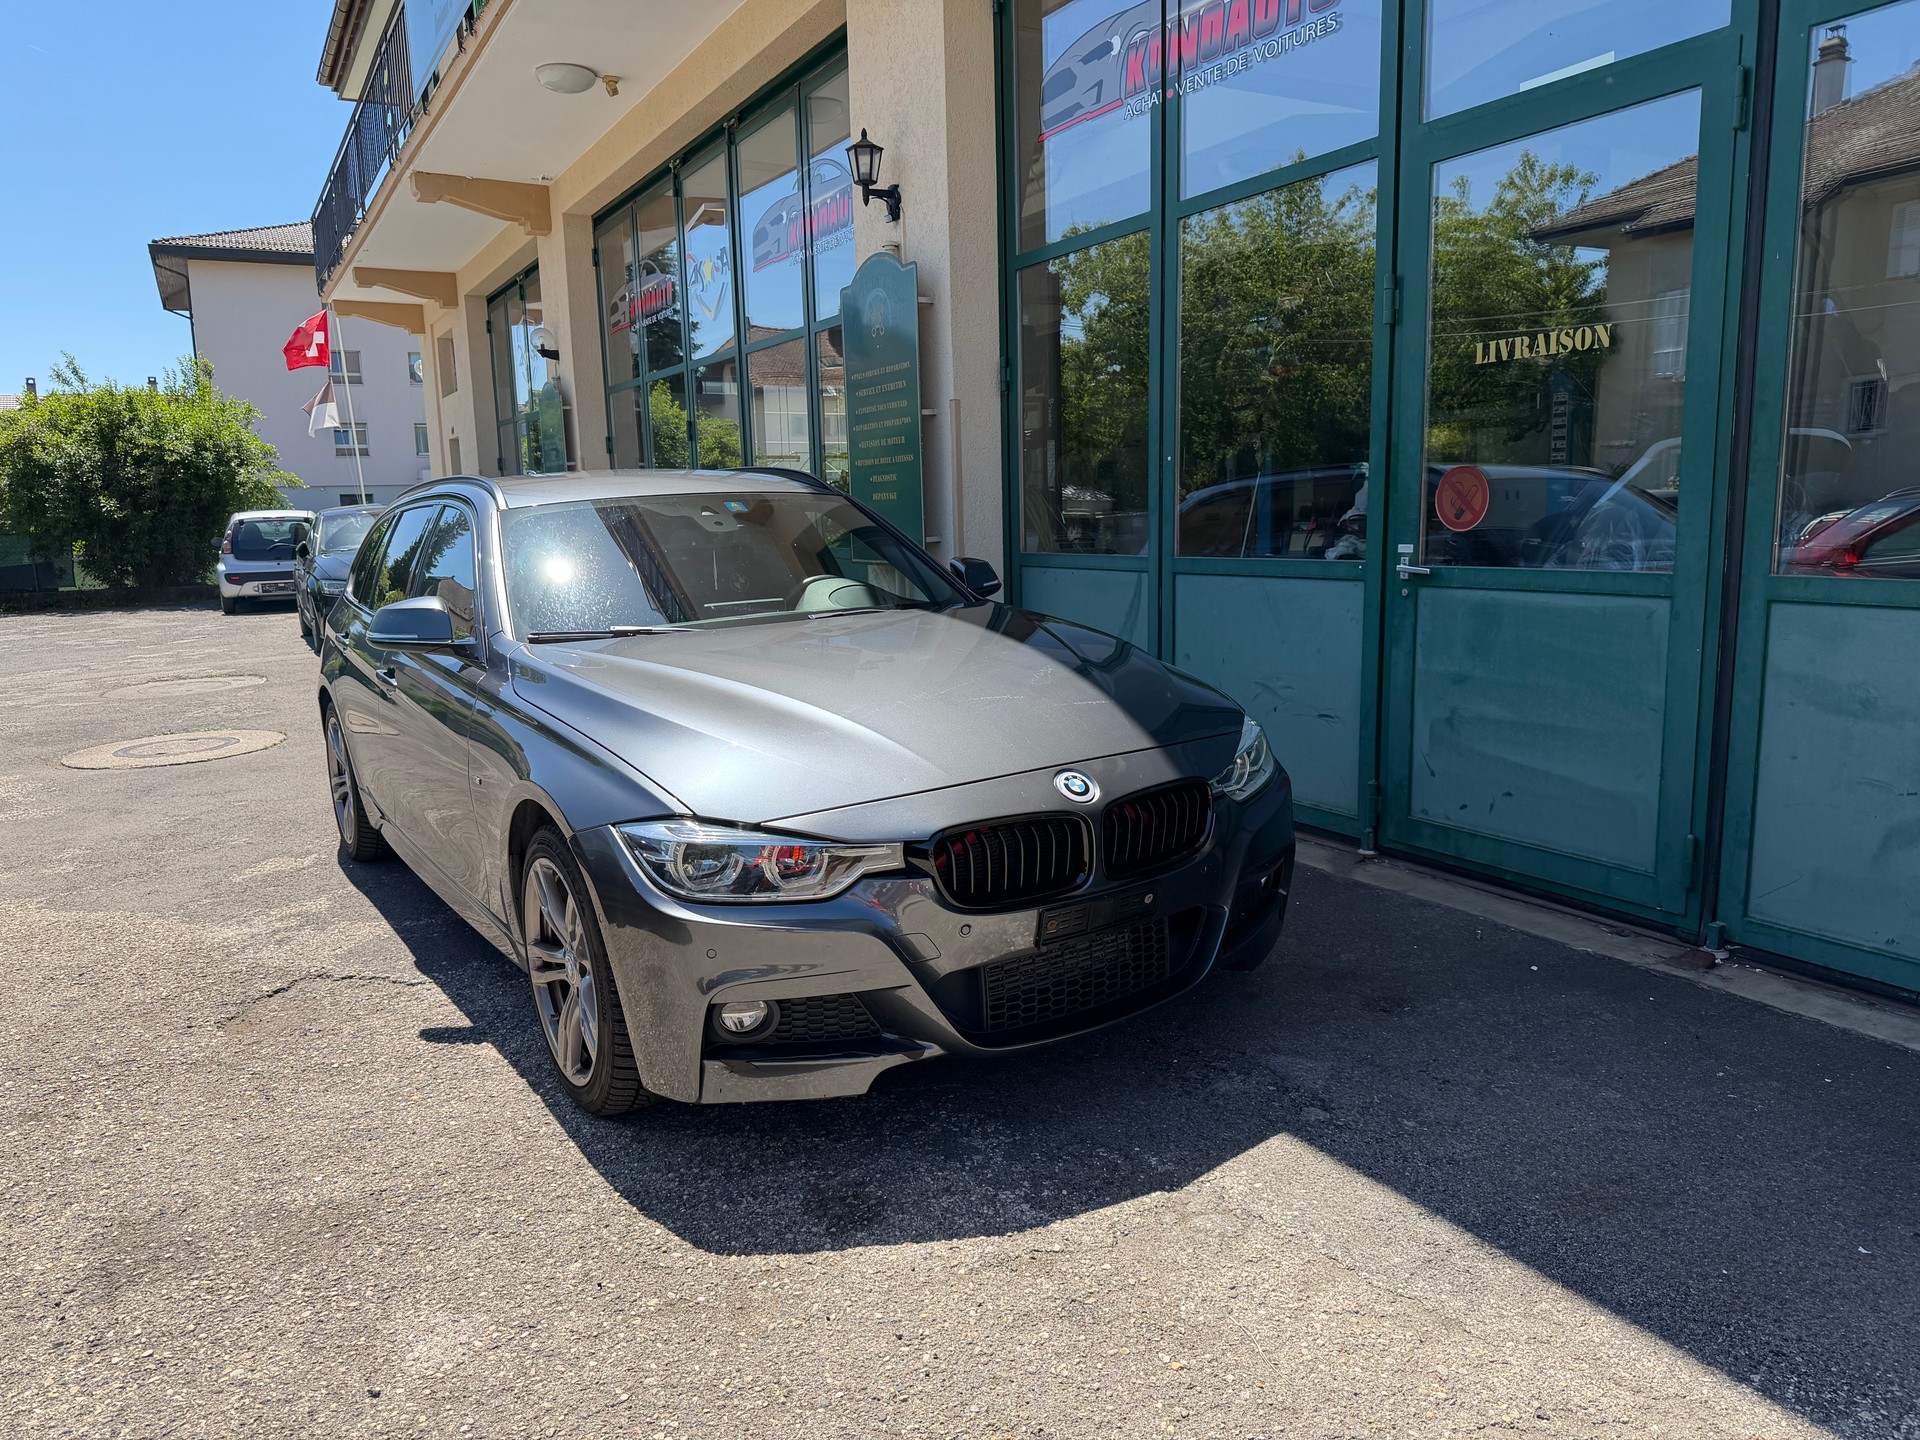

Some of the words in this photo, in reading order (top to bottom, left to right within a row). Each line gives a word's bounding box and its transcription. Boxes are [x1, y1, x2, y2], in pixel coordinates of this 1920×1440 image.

[1124, 89, 1163, 120] ACHAT
[1174, 64, 1223, 96] VENTE
[1226, 52, 1249, 76] DE
[1252, 12, 1338, 63] VOITURES
[1125, 0, 1337, 99] KONOAU
[1474, 323, 1613, 365] LIVRAISON
[872, 474, 897, 483] DIAGNOSTIC
